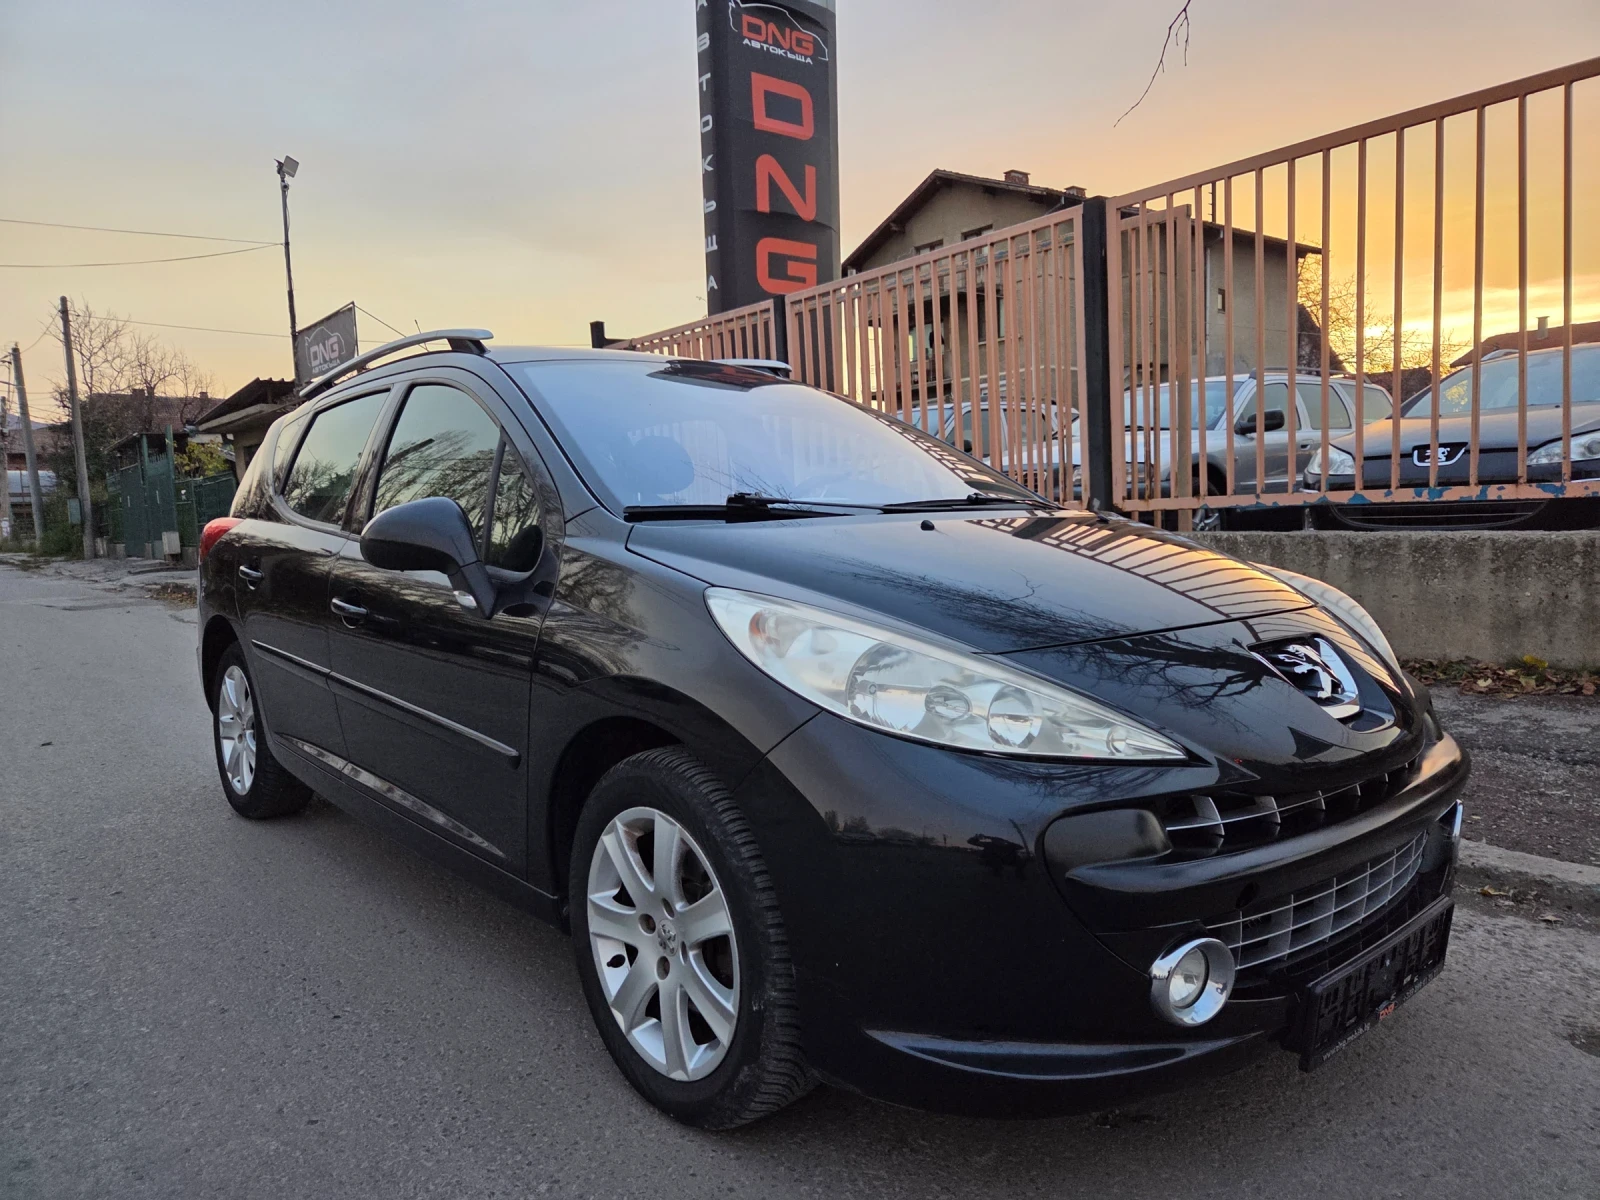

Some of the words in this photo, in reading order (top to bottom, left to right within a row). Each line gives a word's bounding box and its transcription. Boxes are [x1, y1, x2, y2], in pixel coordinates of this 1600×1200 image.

[741, 14, 814, 56] DNG
[742, 38, 813, 65] АВТОКЪЩА
[751, 71, 817, 295] DNG
[310, 336, 339, 367] DNG
